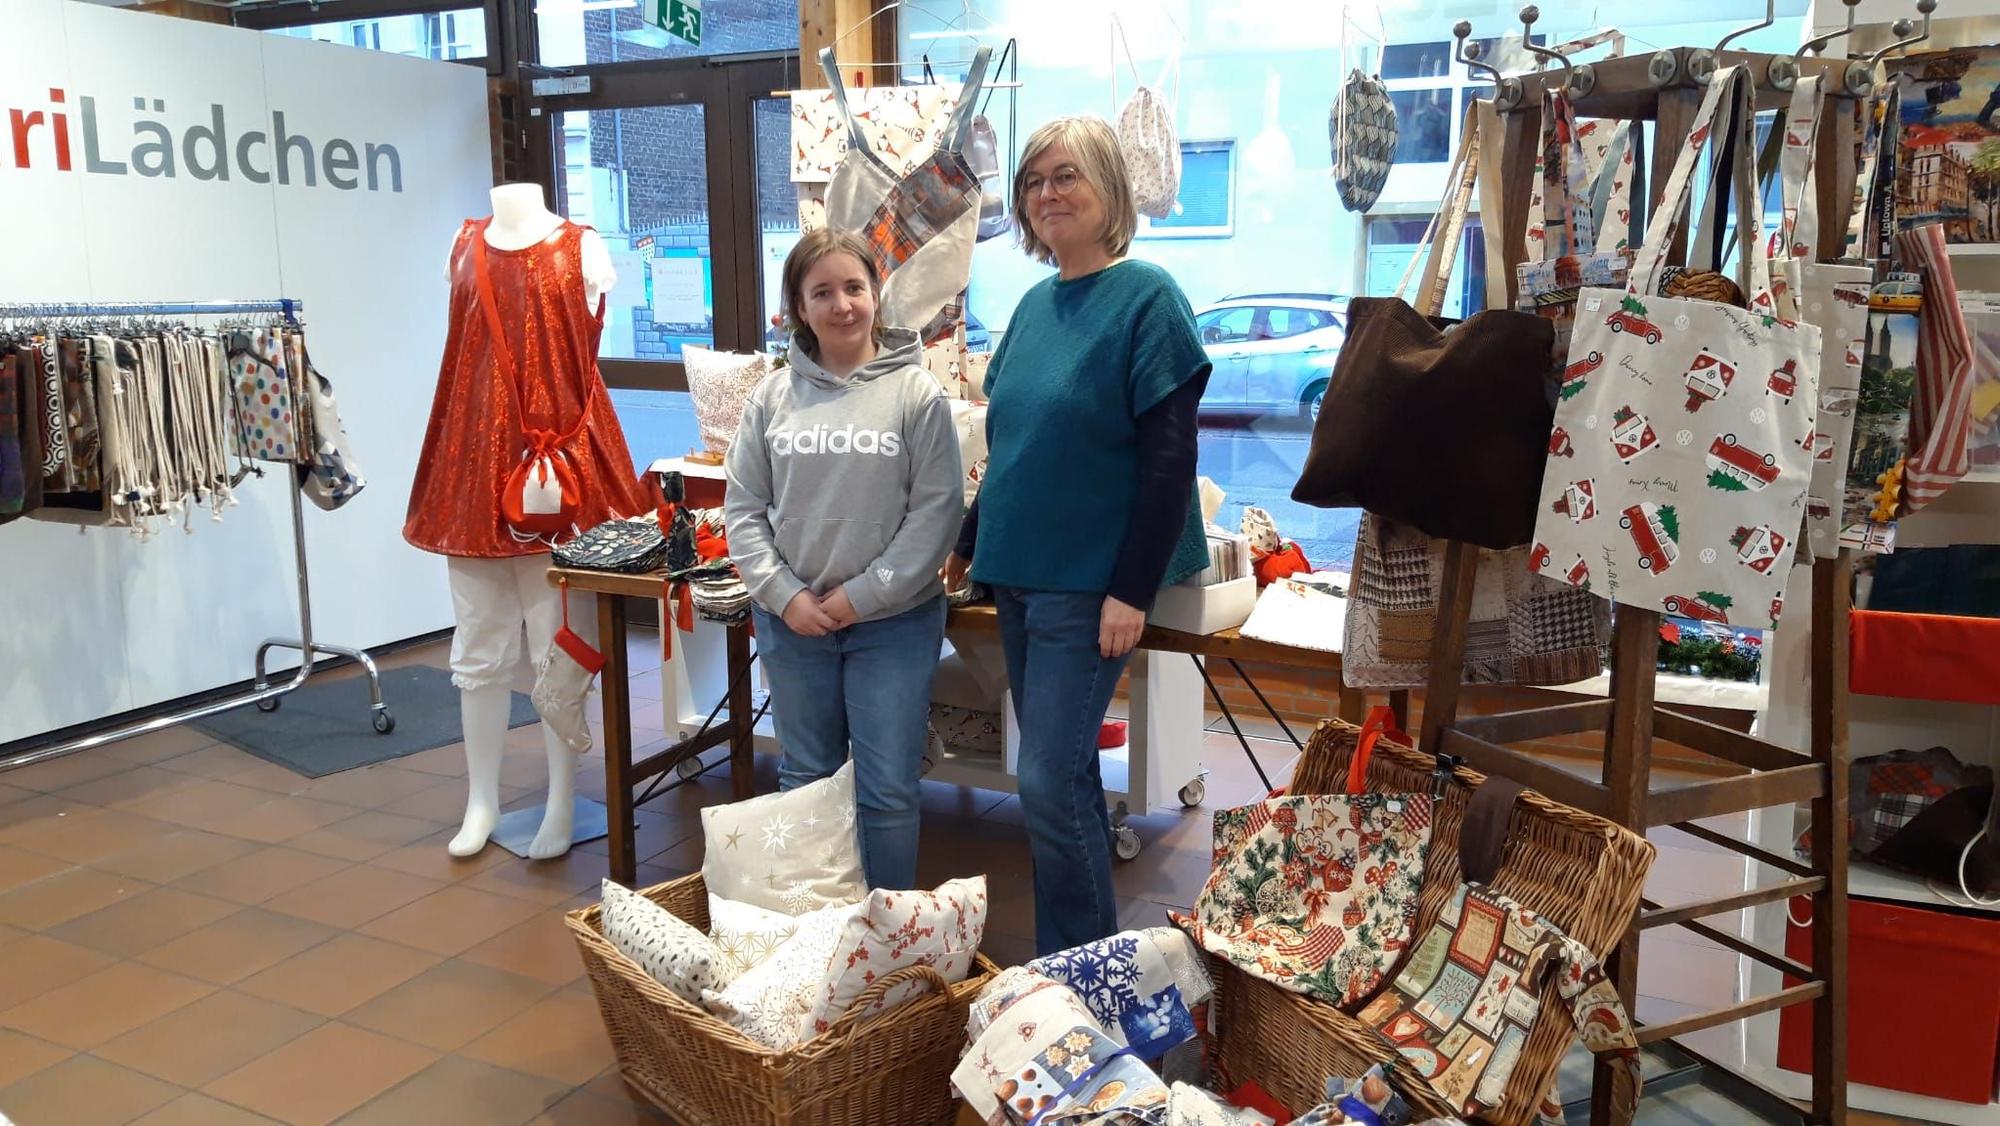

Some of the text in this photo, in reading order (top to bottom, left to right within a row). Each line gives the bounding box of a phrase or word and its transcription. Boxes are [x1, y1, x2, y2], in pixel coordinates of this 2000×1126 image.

[0, 87, 404, 193] riLädchen
[1881, 197, 1891, 237] Uptown
[773, 424, 901, 457] adidas
